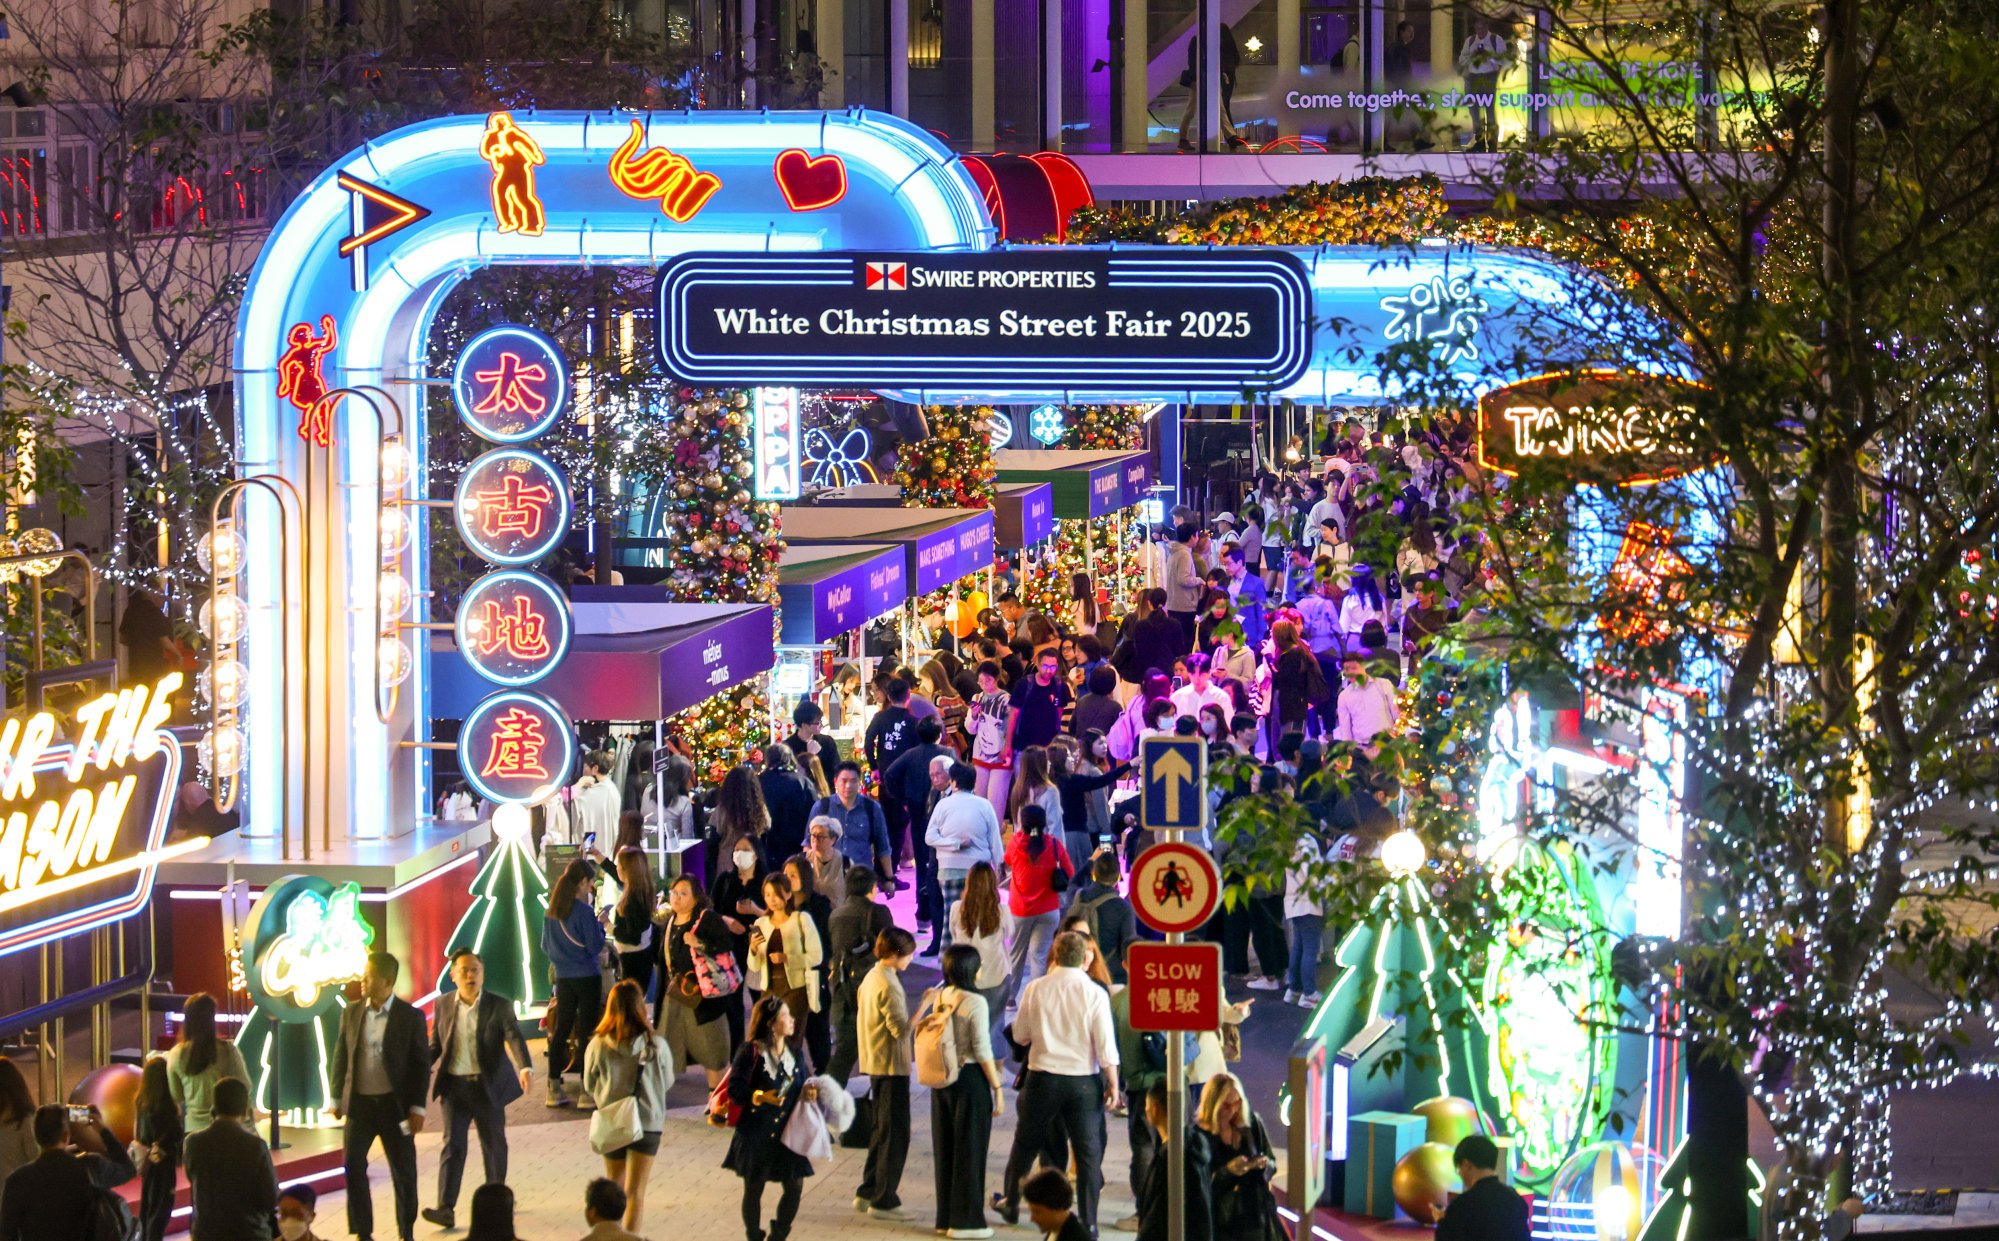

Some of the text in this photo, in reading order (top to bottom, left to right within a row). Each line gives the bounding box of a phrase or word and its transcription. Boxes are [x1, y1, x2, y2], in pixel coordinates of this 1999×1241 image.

[1286, 91, 1343, 108] Come
[1441, 88, 1493, 108] show
[1499, 90, 1574, 111] support
[911, 266, 1096, 288] SWIRE PROPERTIES
[714, 308, 1251, 338] White Christmas Street Fair 2025
[473, 352, 552, 780] 太古地產
[67, 671, 184, 783] THE
[0, 775, 138, 889] ASON
[1144, 962, 1202, 980] SLOW
[1147, 988, 1200, 1014] 慢駛
